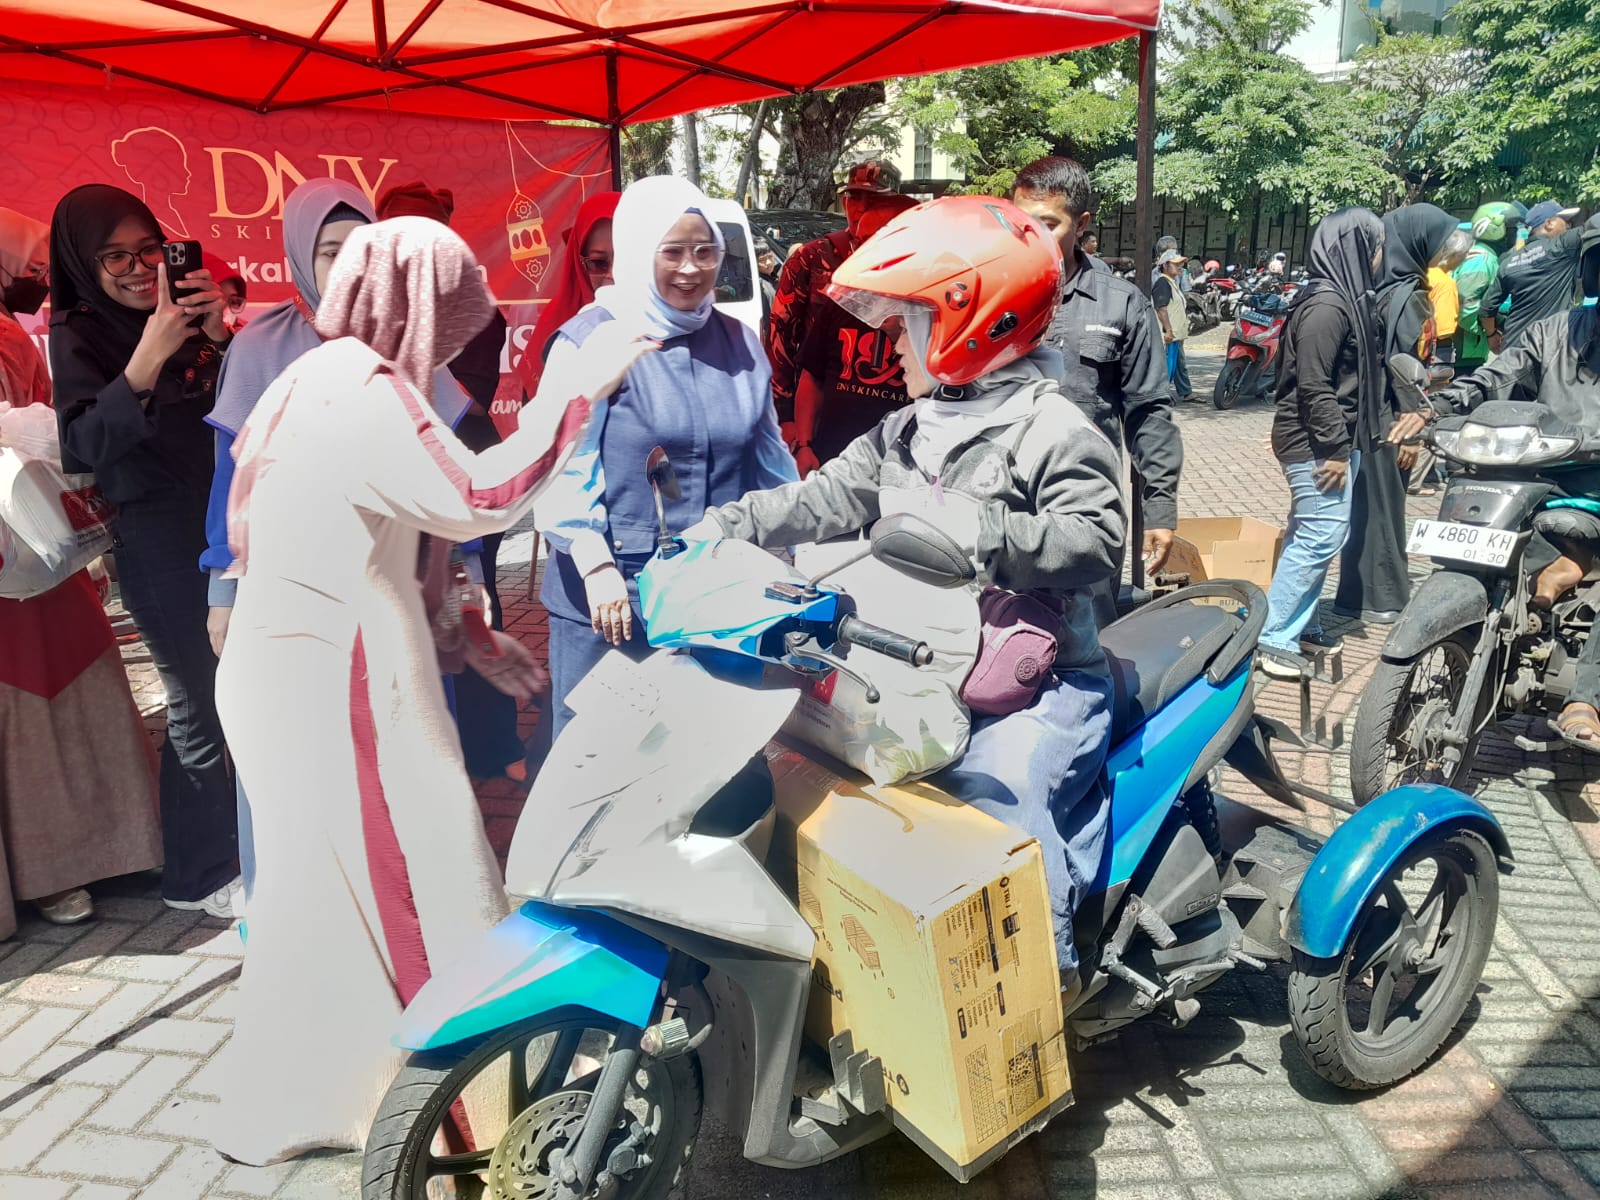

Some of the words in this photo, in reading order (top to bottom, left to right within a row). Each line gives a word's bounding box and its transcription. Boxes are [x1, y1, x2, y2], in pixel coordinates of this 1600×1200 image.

[1464, 485, 1502, 494] HONDA
[1415, 522, 1430, 539] W
[1437, 525, 1480, 545] 4860
[1486, 532, 1514, 552] KH
